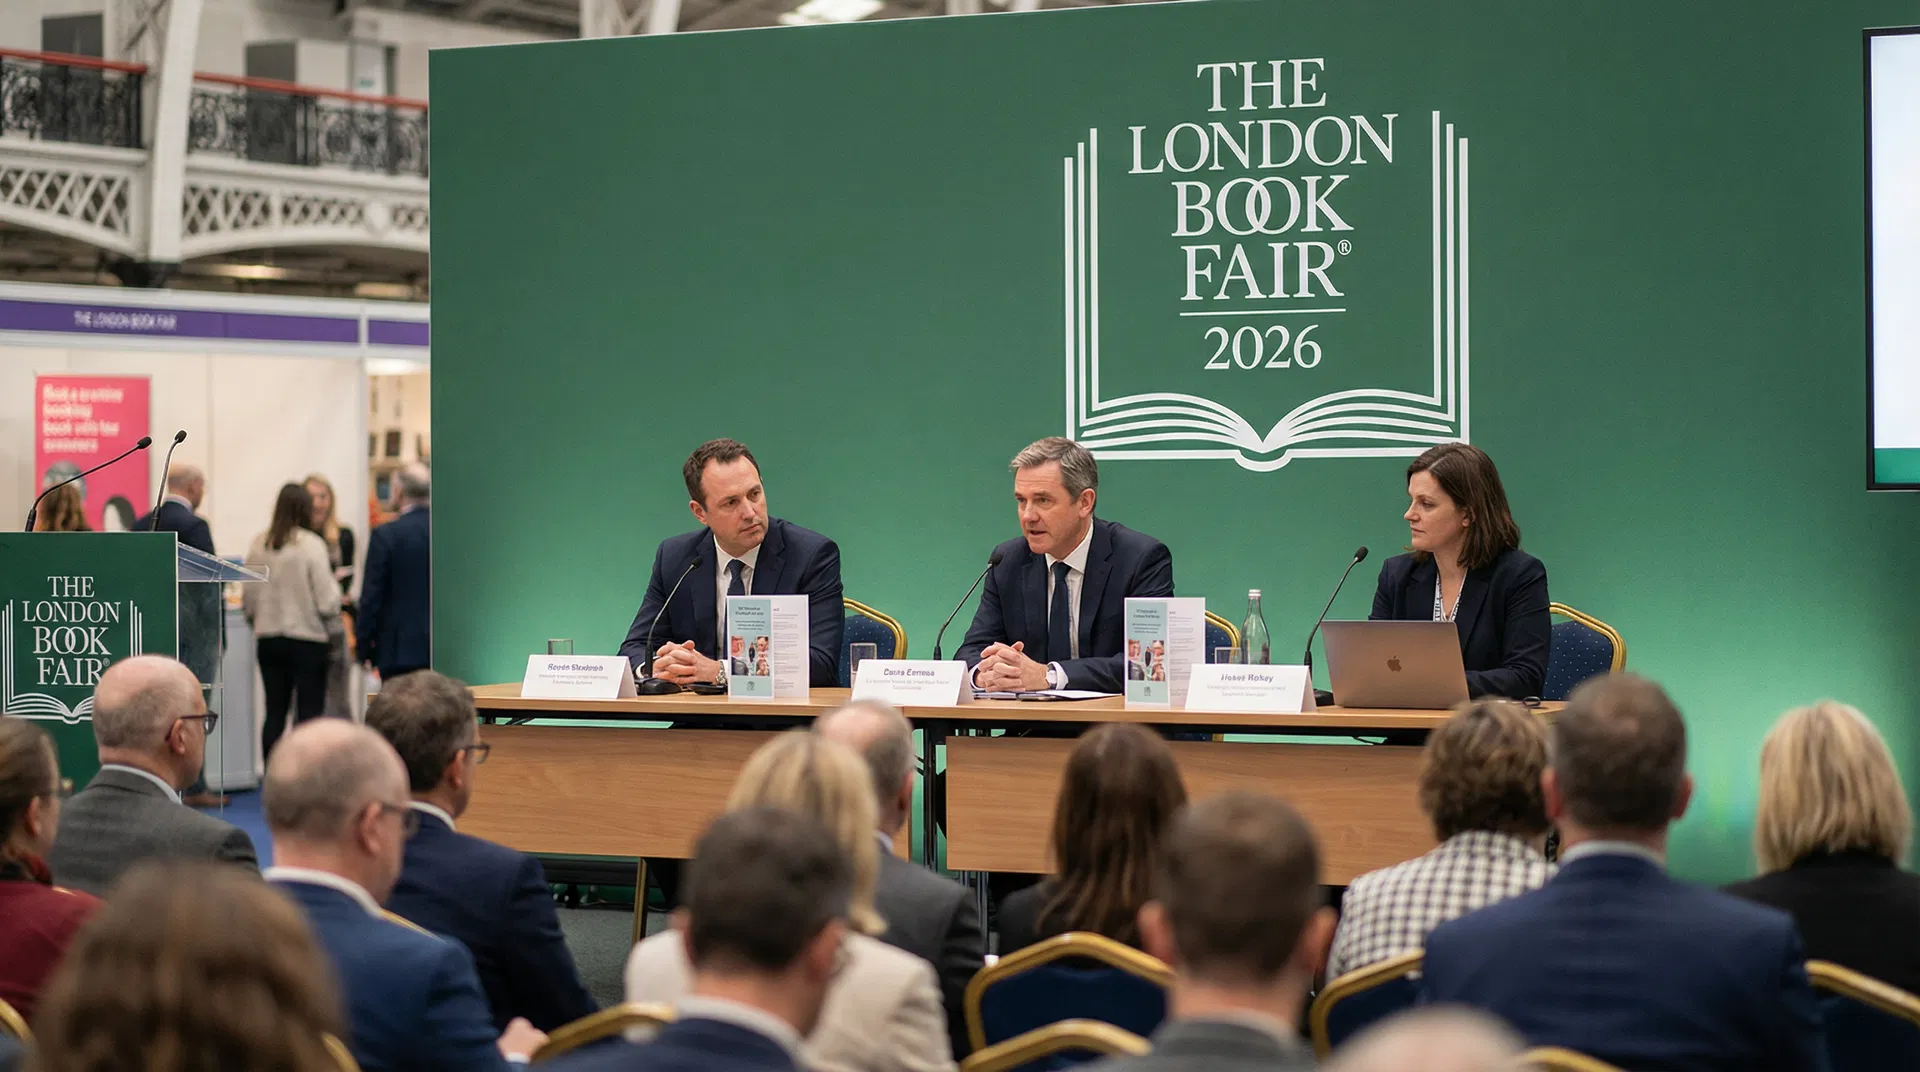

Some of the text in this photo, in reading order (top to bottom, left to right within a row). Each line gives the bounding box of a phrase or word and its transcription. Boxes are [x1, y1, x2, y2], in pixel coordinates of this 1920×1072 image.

[1197, 57, 1327, 111] THE
[1128, 113, 1398, 174] LONDON
[1171, 174, 1354, 237] BOOK
[1203, 324, 1322, 370] 2026
[47, 576, 95, 598] THE
[22, 600, 121, 623] LONDON
[33, 626, 112, 655] BOOK
